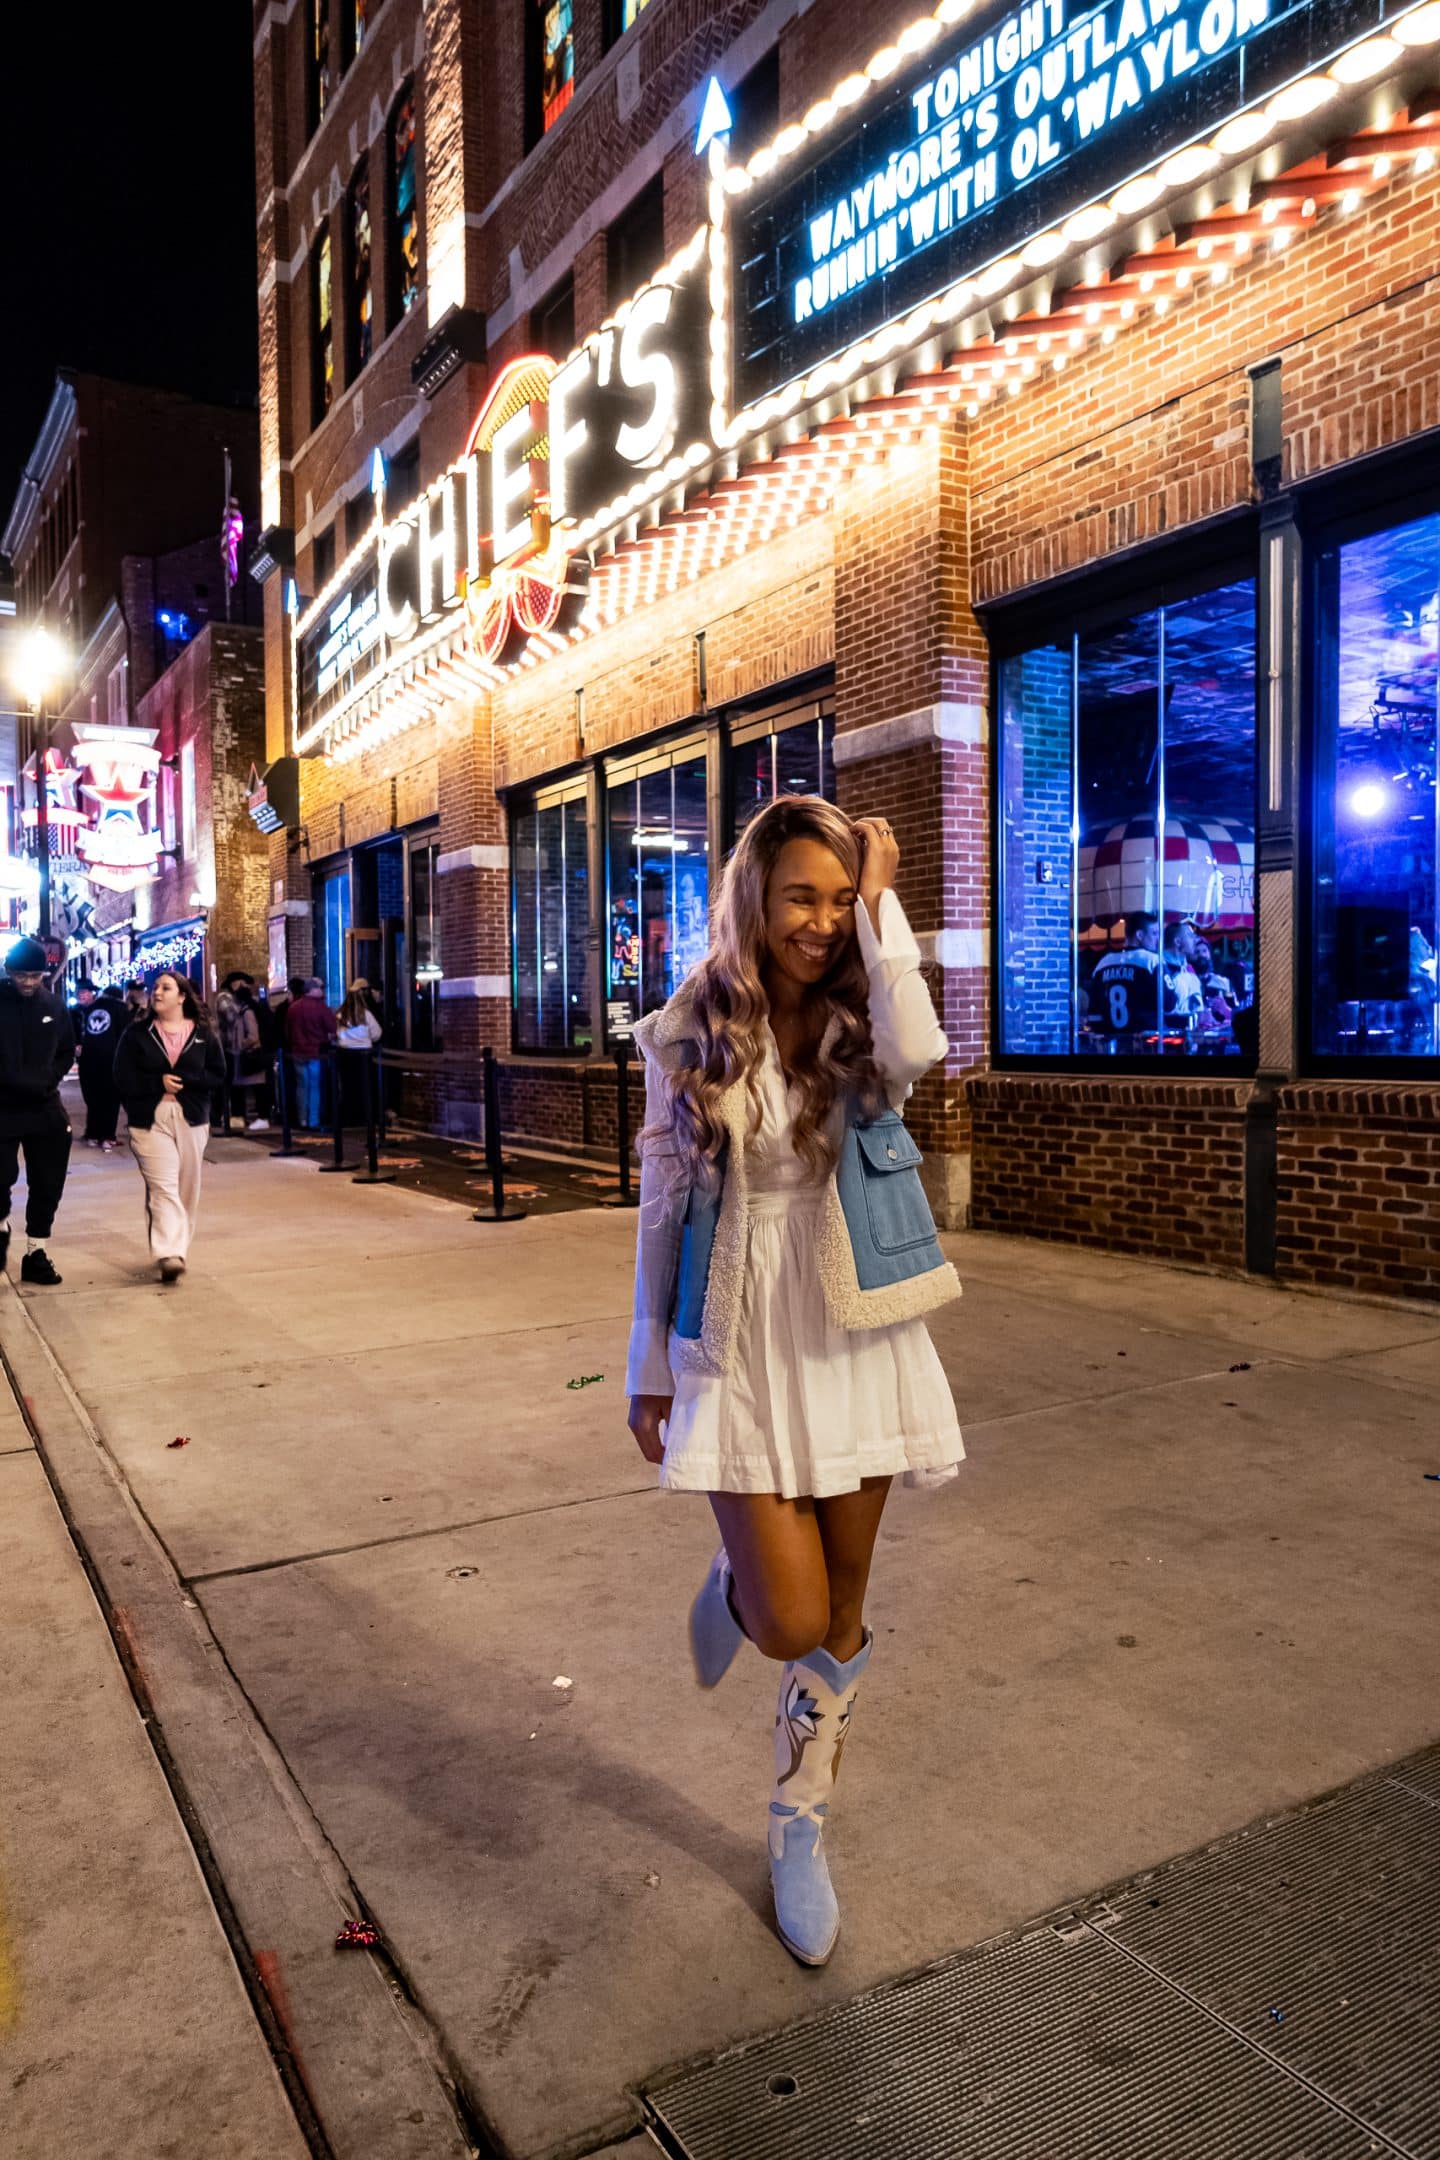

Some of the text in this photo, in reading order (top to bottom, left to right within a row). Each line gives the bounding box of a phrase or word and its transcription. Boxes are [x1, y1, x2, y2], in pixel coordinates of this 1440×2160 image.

[913, 0, 1063, 134] TONIGHT
[810, 94, 999, 262] WAYMORE'S
[381, 284, 677, 641] CHIEF'S
[1109, 984, 1129, 1028] 8
